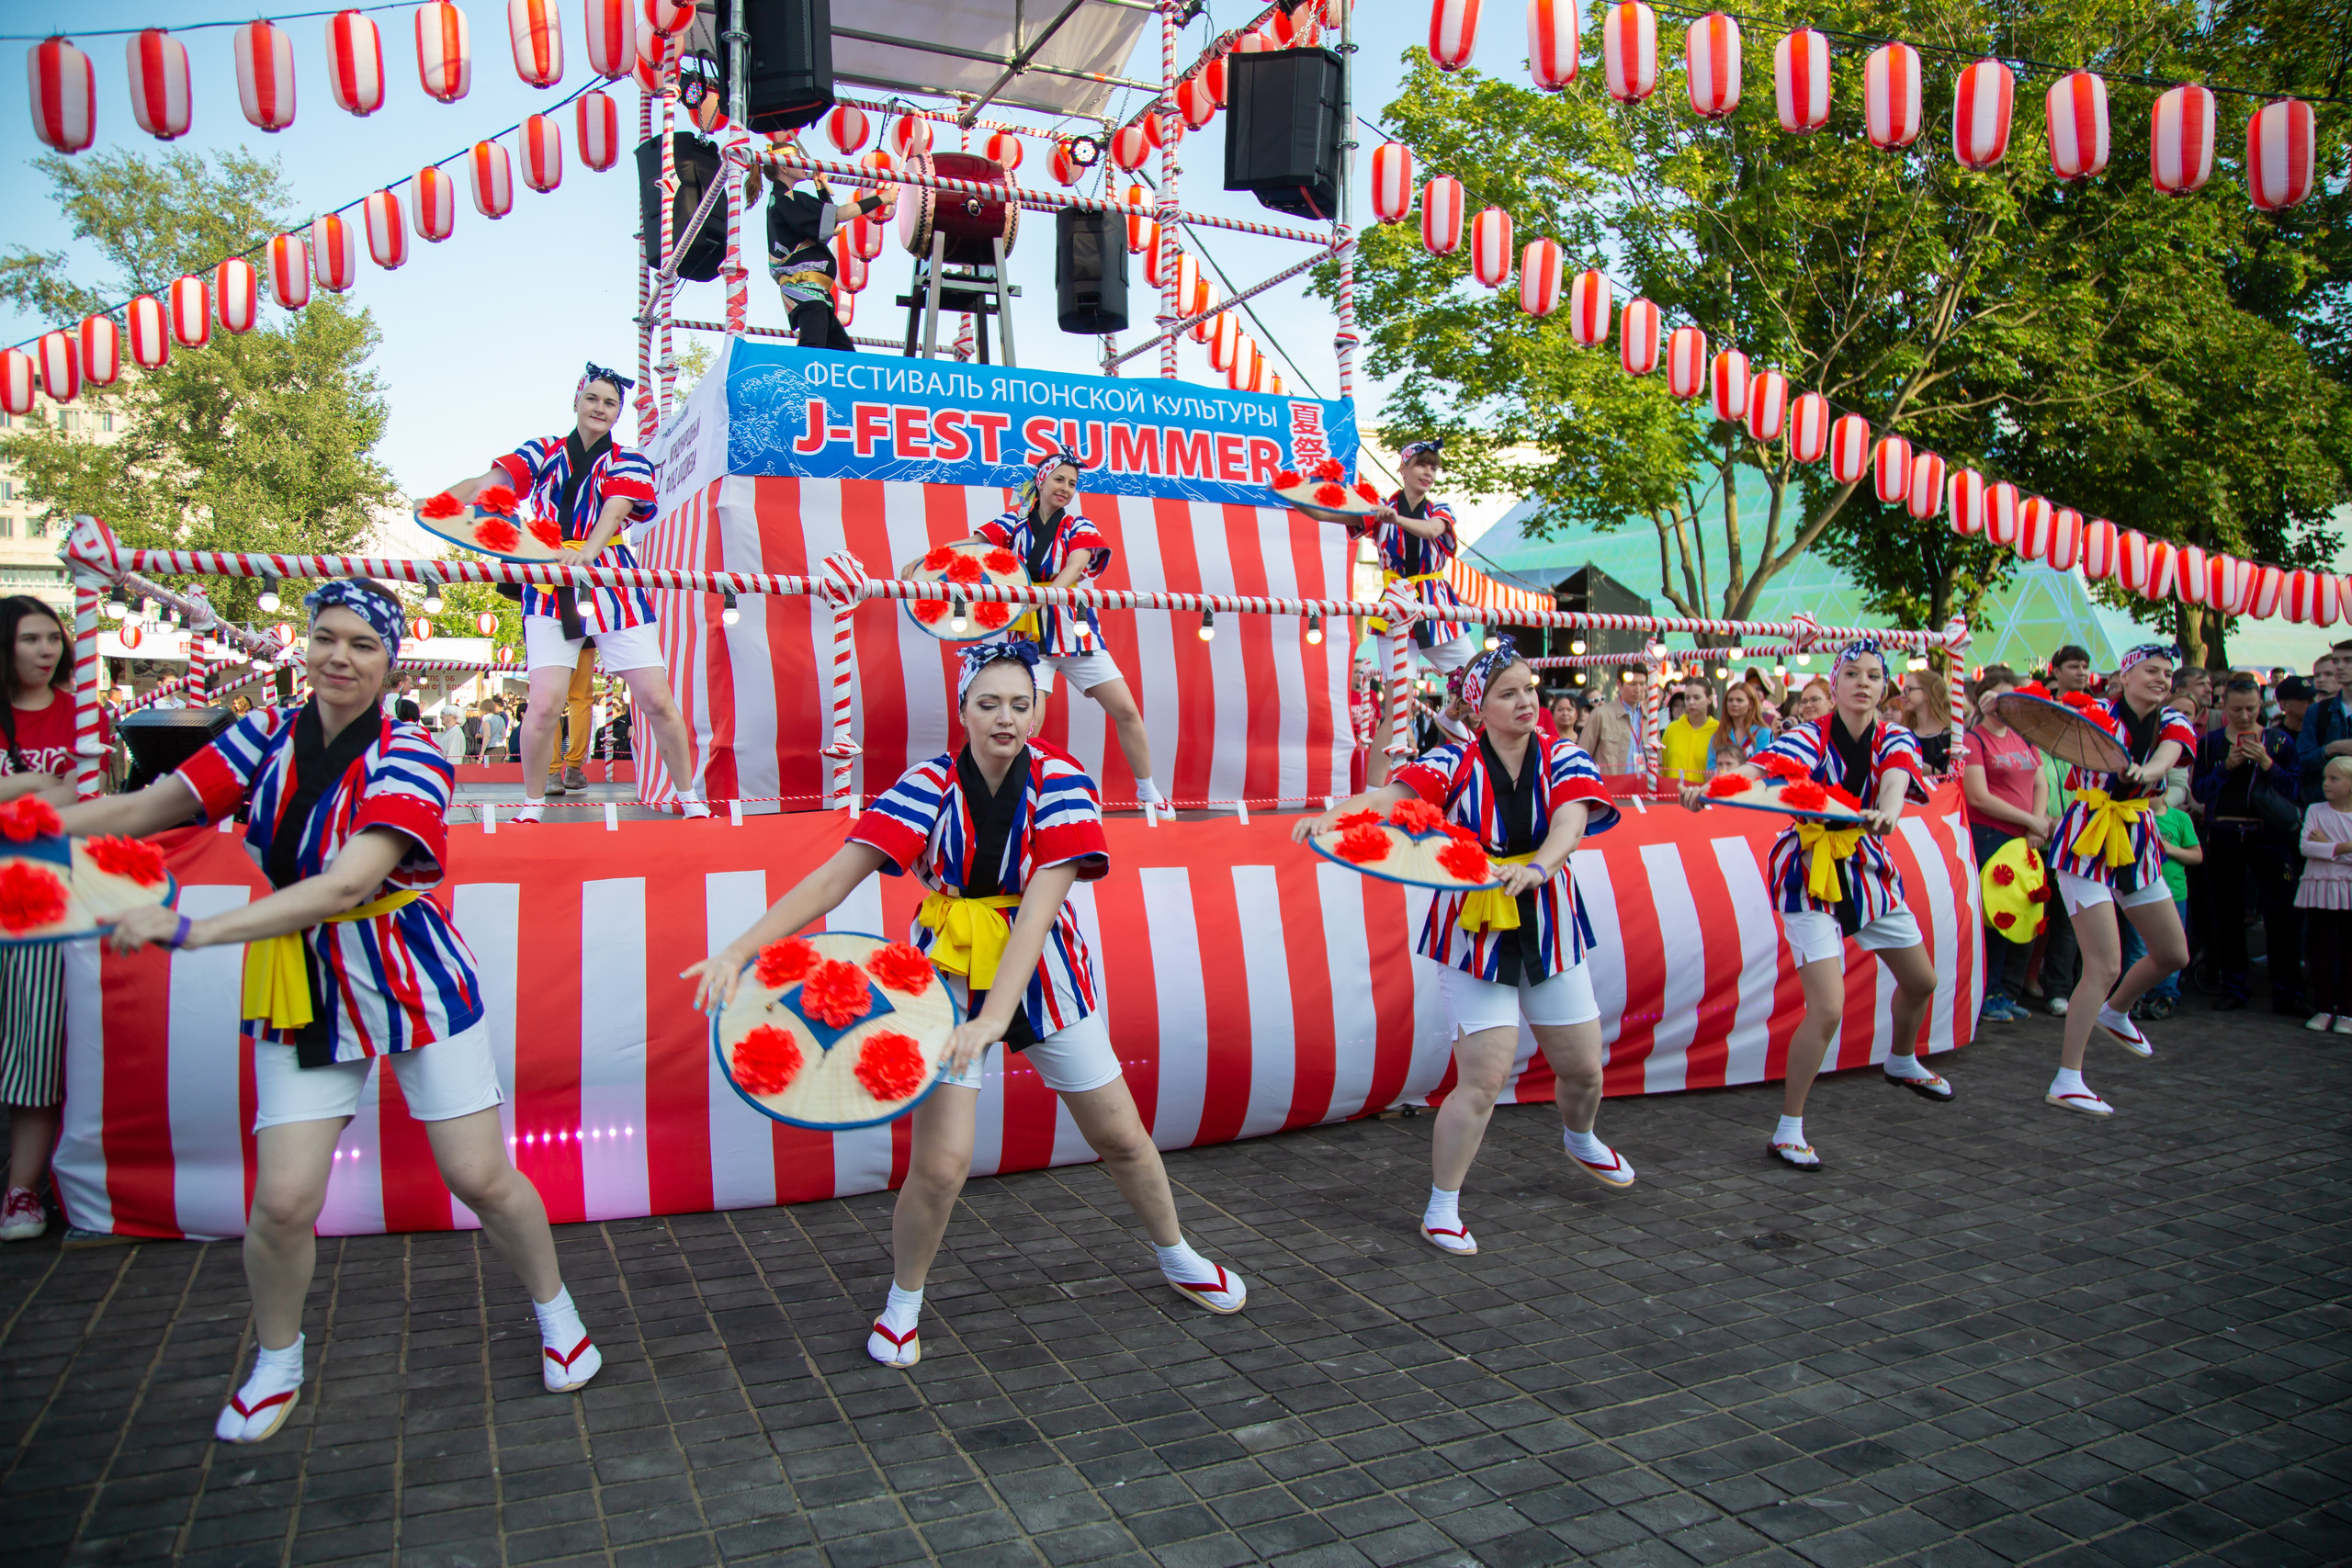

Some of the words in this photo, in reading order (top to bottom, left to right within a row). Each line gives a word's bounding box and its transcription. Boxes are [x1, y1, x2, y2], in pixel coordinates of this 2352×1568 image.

[804, 361, 984, 399] ФЕСТИВАЛЬ
[991, 378, 1146, 413] ЯПОНСКОЙ
[1152, 394, 1278, 427] КУЛЬТУРЫ
[795, 400, 1010, 464] J-FEST
[1023, 417, 1283, 484] SUMMER
[1290, 403, 1326, 478] 夏祭
